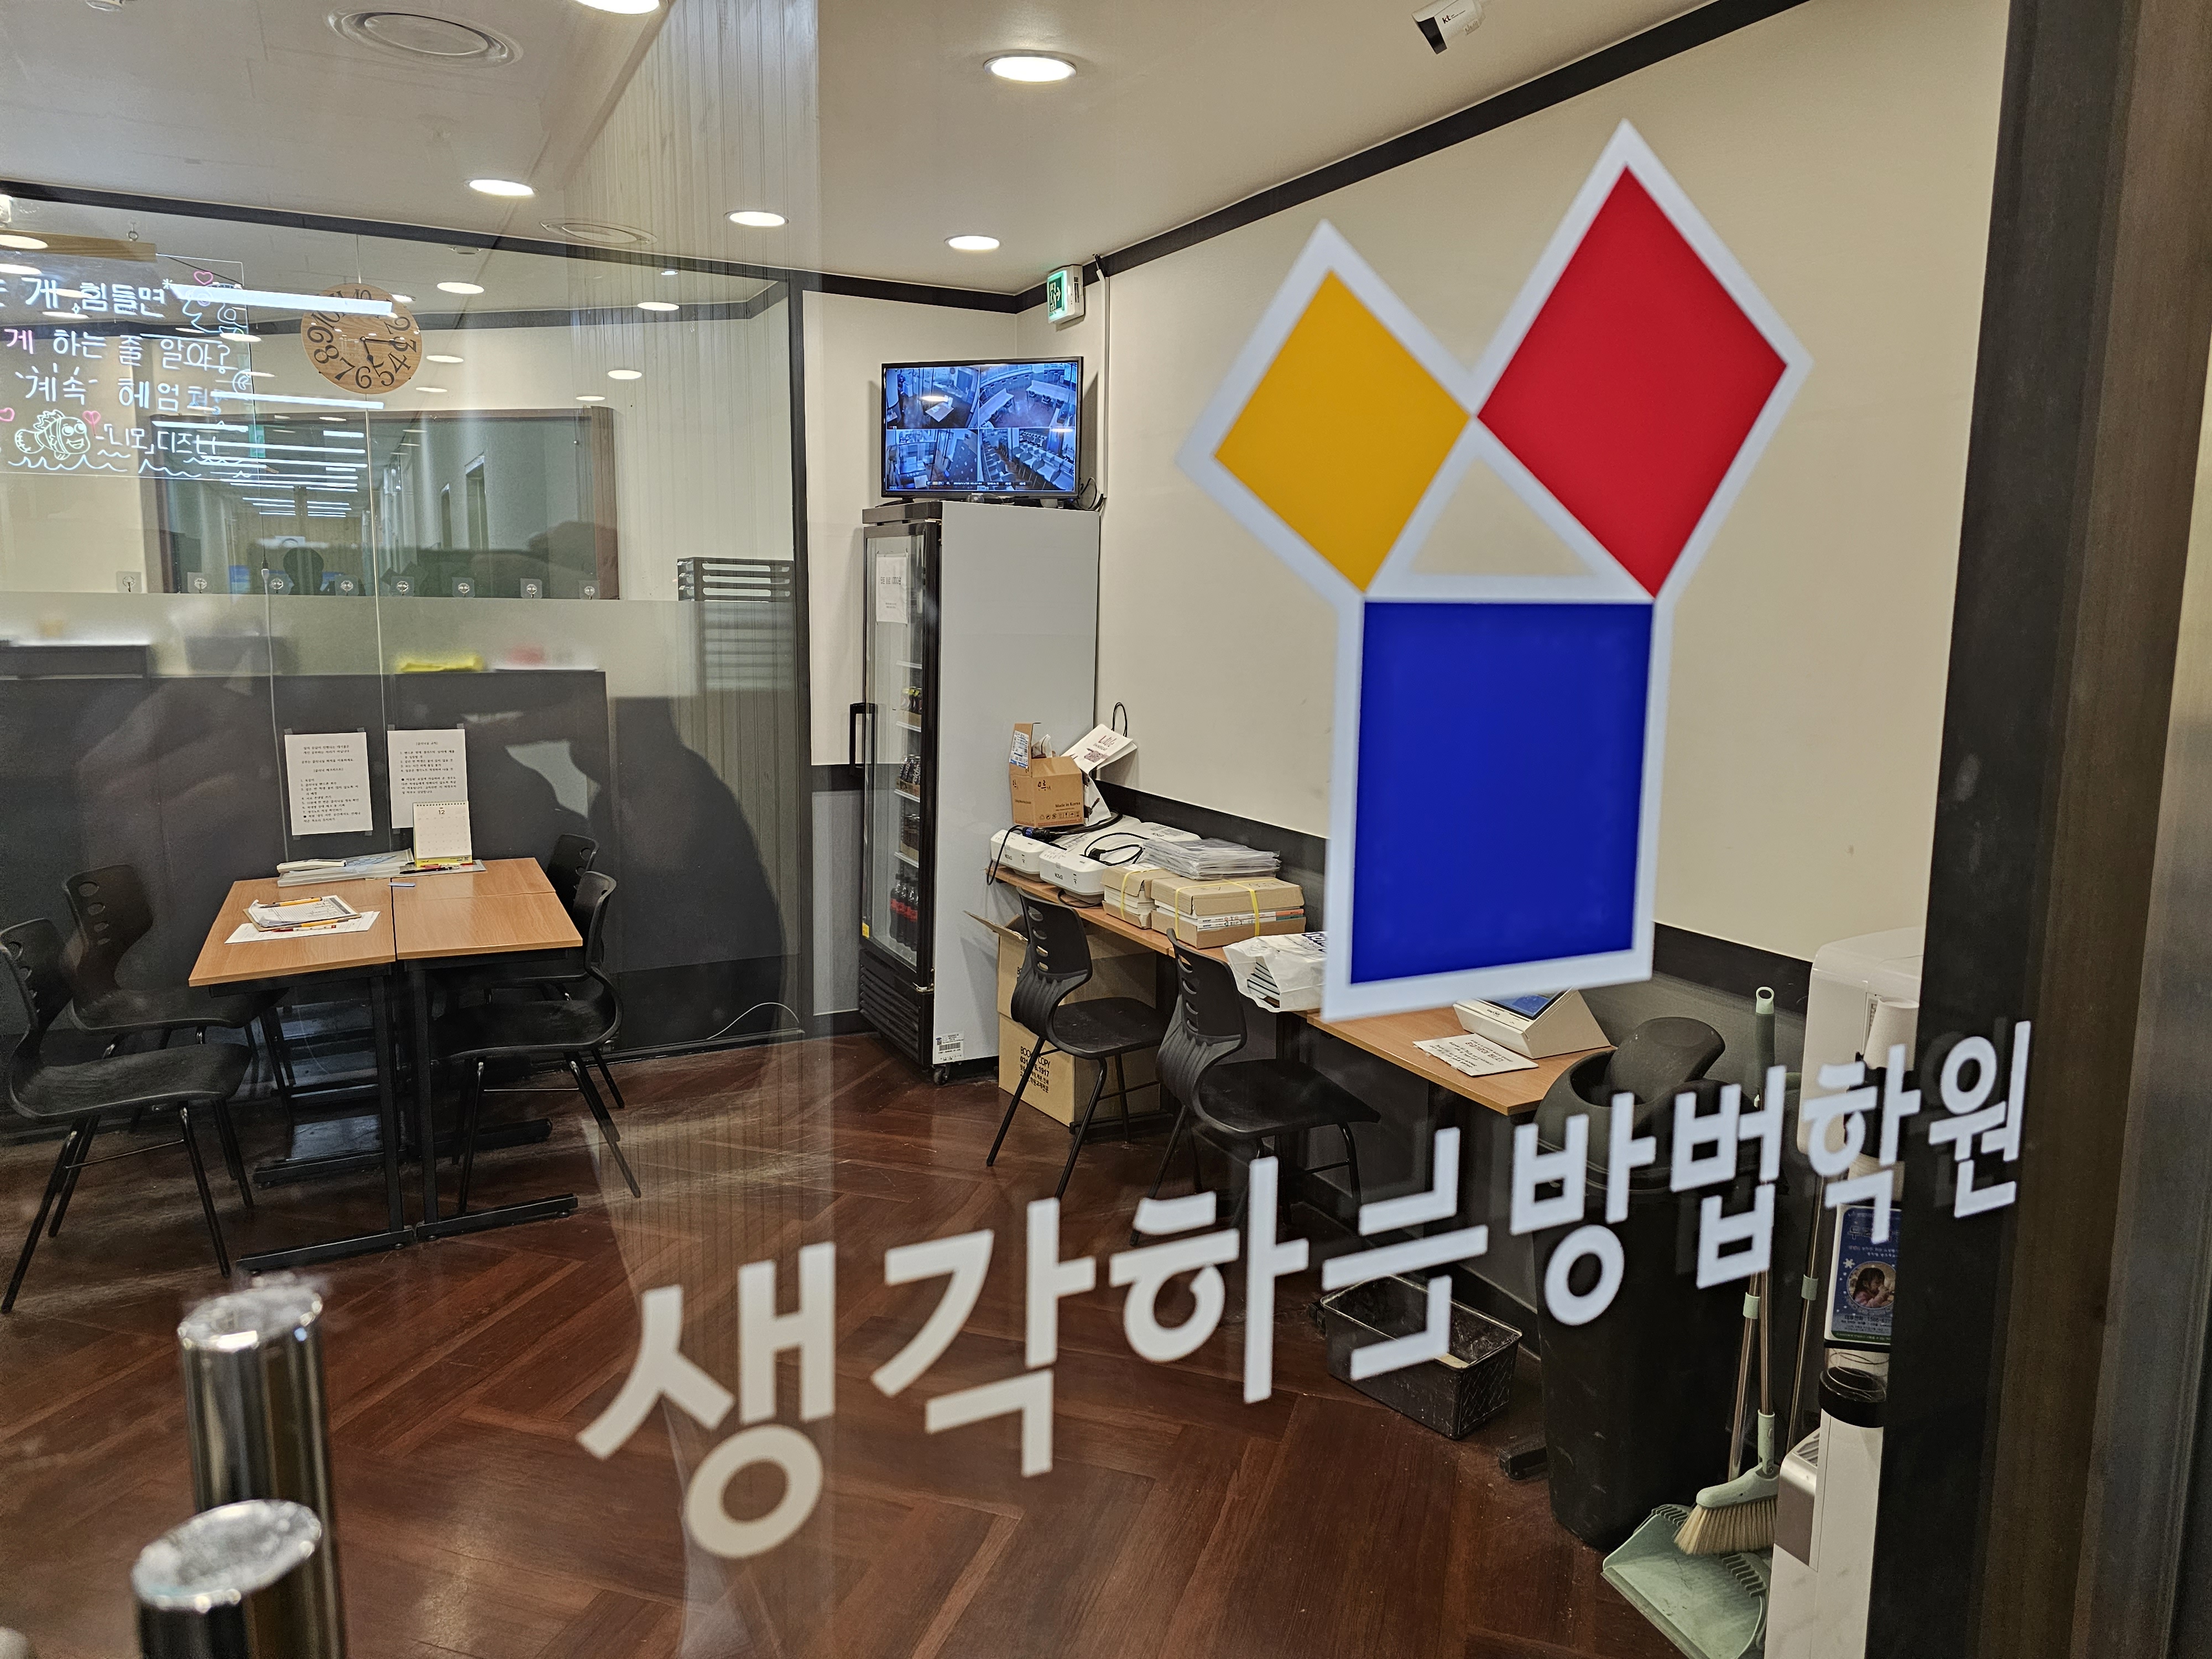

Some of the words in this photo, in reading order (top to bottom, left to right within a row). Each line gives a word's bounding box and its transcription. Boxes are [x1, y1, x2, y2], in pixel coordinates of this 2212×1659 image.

[1442, 14, 1452, 24] kt
[21, 276, 59, 309] 게
[80, 281, 166, 318] 힘들면
[307, 325, 334, 343] 9
[384, 316, 411, 335] 2
[53, 329, 107, 358] 하는
[118, 335, 144, 367] 줄
[314, 344, 340, 364] 8
[334, 357, 356, 381] 7
[388, 351, 411, 374] 4
[355, 366, 372, 389] 6
[25, 375, 87, 405] 계속
[1038, 1056, 1051, 1069] COPY
